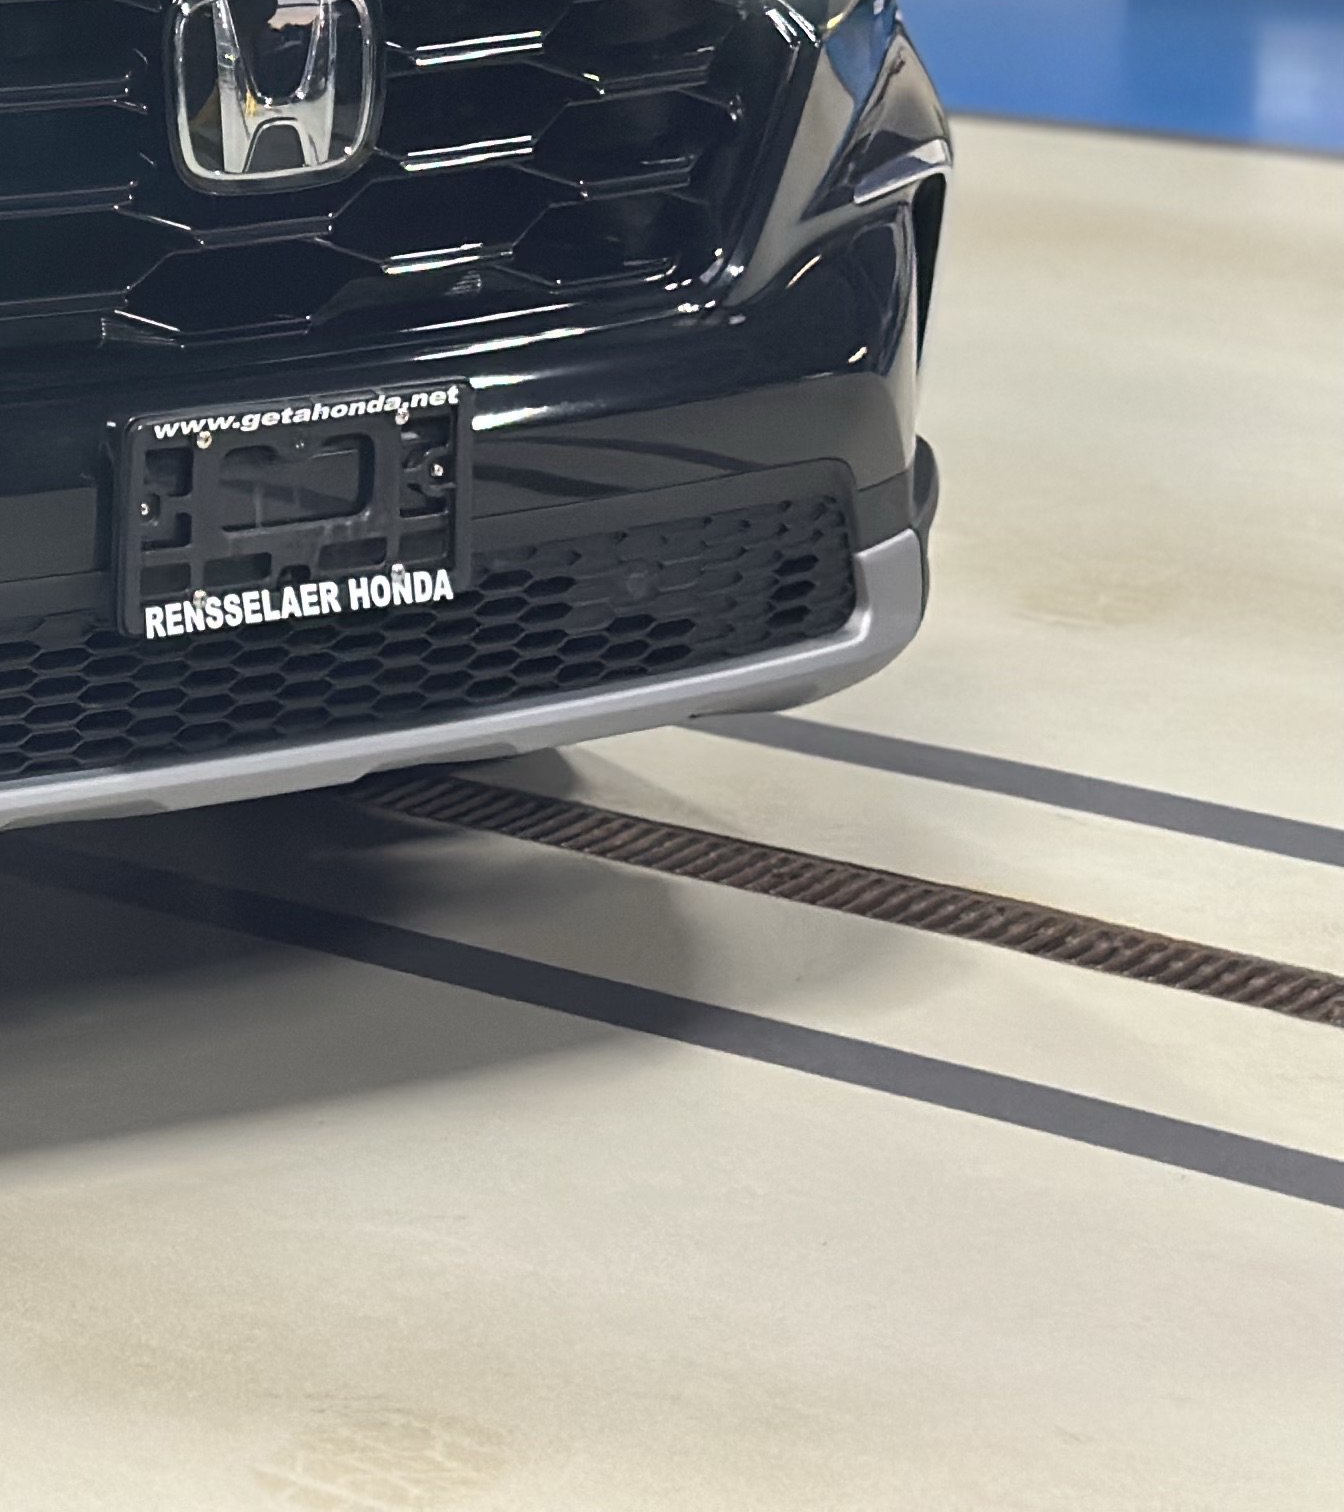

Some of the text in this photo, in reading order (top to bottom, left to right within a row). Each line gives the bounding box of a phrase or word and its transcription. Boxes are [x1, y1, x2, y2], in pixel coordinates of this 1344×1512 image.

[152, 384, 460, 440] www.getahonda.net
[144, 568, 455, 639] RENSSELAER HONDA
